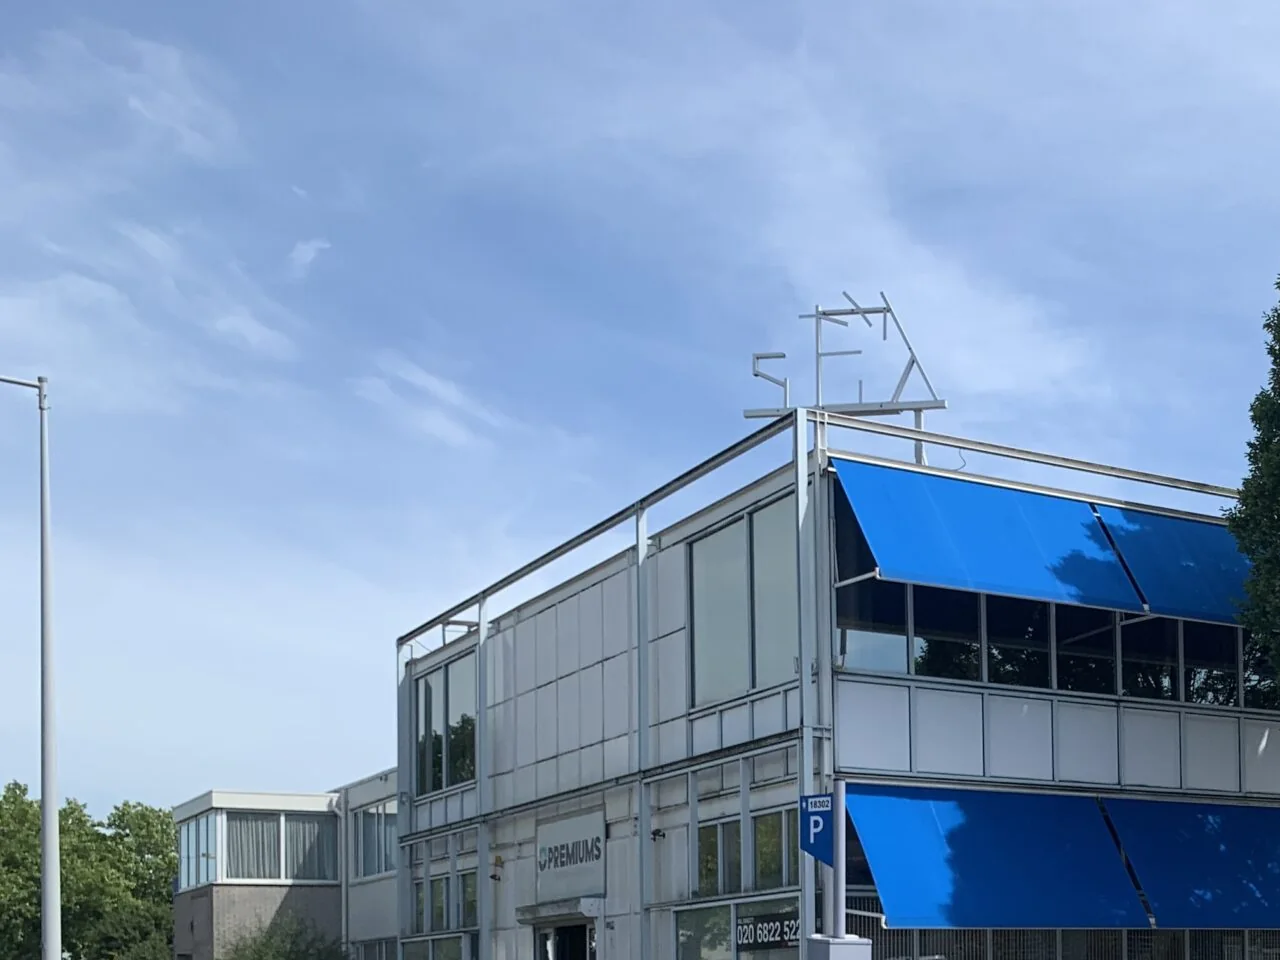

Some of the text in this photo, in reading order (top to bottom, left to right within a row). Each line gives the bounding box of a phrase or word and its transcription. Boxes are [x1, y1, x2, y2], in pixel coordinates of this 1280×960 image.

[810, 800, 830, 809] 18302
[810, 815, 824, 844] P
[547, 836, 602, 870] PREMIUMS
[737, 924, 754, 944] 020
[757, 921, 781, 943] 6822
